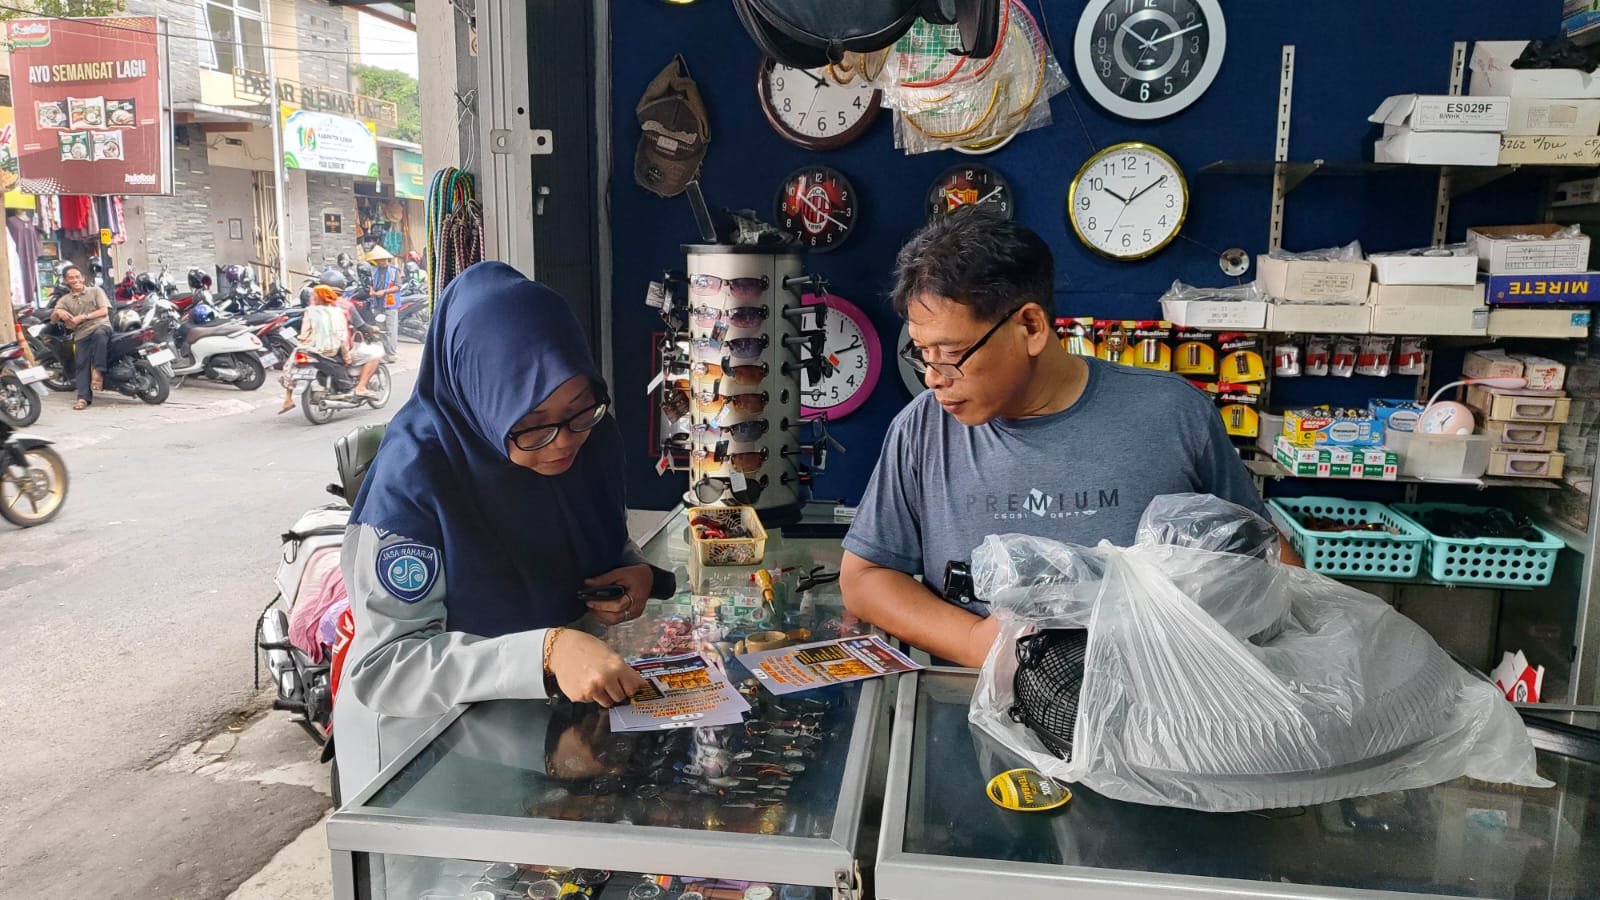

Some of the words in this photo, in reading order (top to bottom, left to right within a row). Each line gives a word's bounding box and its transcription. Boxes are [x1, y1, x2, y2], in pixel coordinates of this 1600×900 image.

[1104, 13, 1118, 31] 10
[1098, 37, 1107, 55] 9
[1190, 36, 1200, 54] 3
[29, 65, 50, 84] AYO
[52, 61, 114, 82] SEMANGAT
[116, 59, 147, 78] LAGI!
[1103, 60, 1111, 78] 8
[1181, 60, 1190, 77] 4
[776, 77, 785, 91] 9
[1120, 77, 1128, 94] 7
[1164, 77, 1173, 95] 5
[1139, 82, 1150, 101] 6
[783, 98, 791, 112] 8
[852, 96, 862, 110] 4
[1446, 103, 1493, 113] ES029F
[798, 113, 806, 127] 7
[817, 117, 827, 131] 6
[838, 111, 846, 126] 5
[1103, 163, 1116, 176] 11
[1121, 156, 1137, 170] 12
[1144, 162, 1150, 174] 1
[815, 173, 823, 182] 12
[952, 175, 957, 184] 11
[965, 170, 974, 180] 12
[1158, 175, 1168, 188] 2
[1088, 177, 1103, 191] 10
[842, 191, 848, 200] 2
[938, 187, 946, 197] 10
[782, 202, 787, 211] 9
[1001, 202, 1006, 212] 3
[1081, 197, 1090, 210] 9
[1165, 194, 1174, 208] 3
[846, 208, 851, 217] 3
[933, 204, 938, 213] 9
[786, 219, 791, 228] 8
[1088, 217, 1097, 230] 8
[1157, 215, 1166, 227] 4
[811, 237, 816, 246] 6
[827, 234, 832, 243] 5
[1104, 230, 1113, 243] 7
[1122, 234, 1131, 247] 6
[1142, 229, 1152, 242] 5
[1509, 281, 1589, 295] MIRETE
[840, 319, 844, 333] 1
[1134, 329, 1169, 338] Alkaline
[851, 335, 859, 348] 2
[1221, 341, 1256, 350] Alkaline
[856, 355, 863, 369] 3
[846, 375, 855, 387] 4
[831, 386, 839, 399] 5
[1220, 394, 1257, 402] Alkaline
[965, 488, 1119, 513] PREMIUM
[382, 550, 400, 561] JASA
[401, 547, 433, 560] RAHARJA
